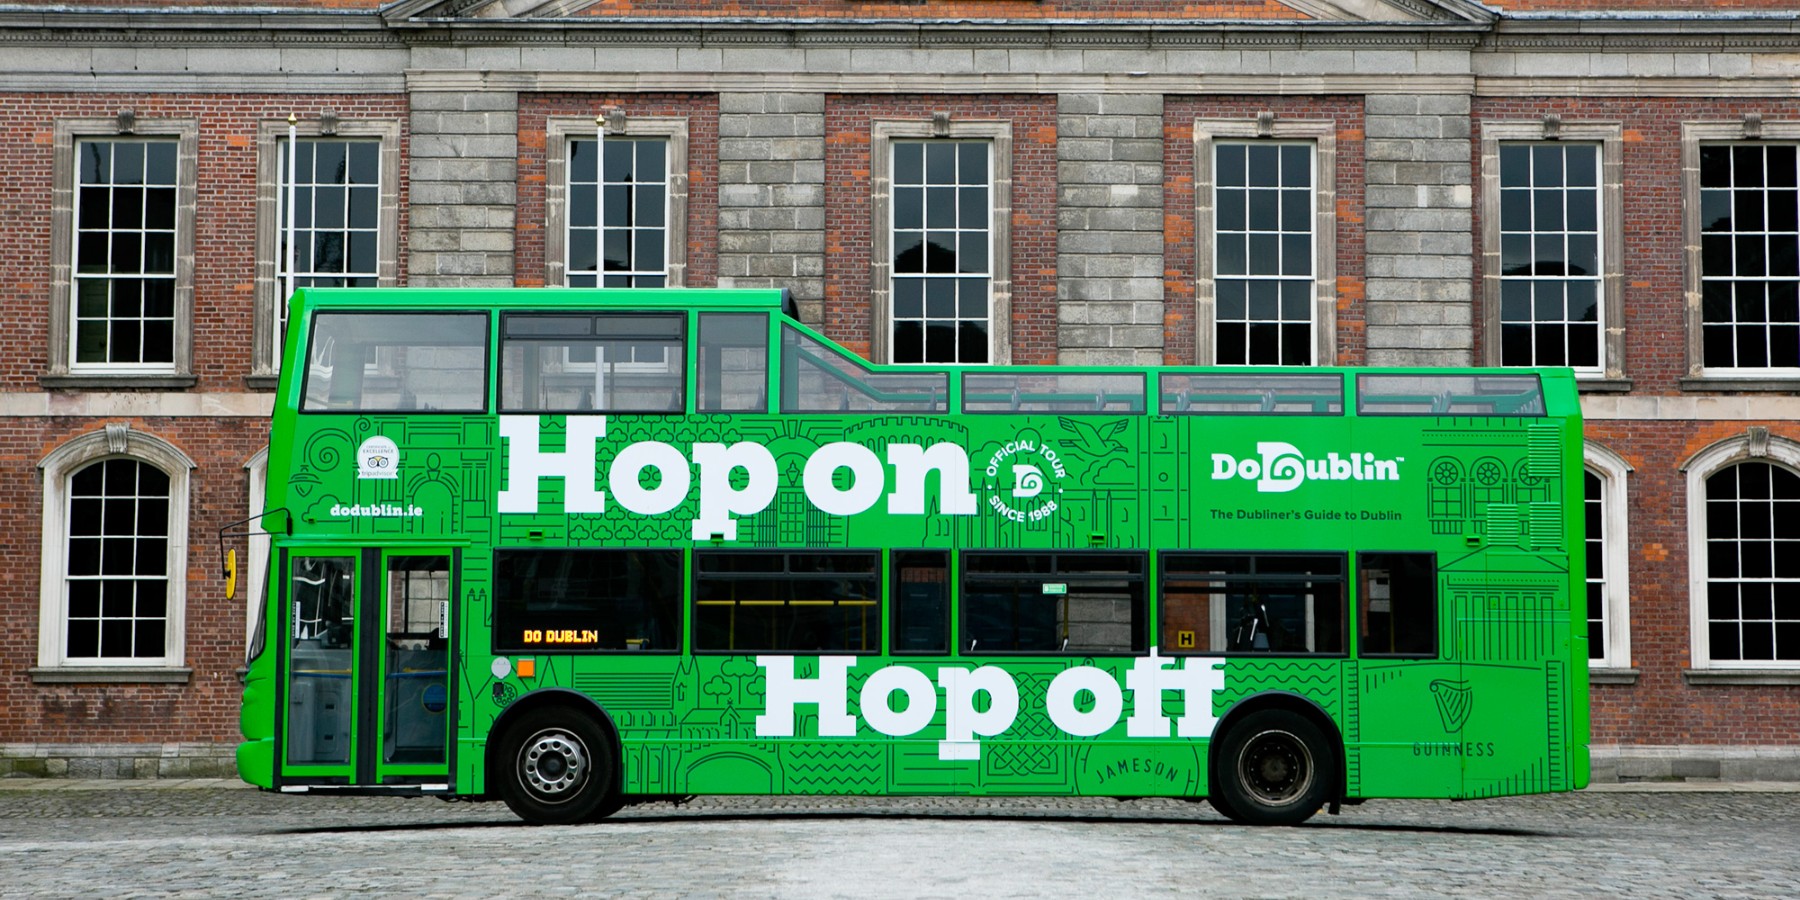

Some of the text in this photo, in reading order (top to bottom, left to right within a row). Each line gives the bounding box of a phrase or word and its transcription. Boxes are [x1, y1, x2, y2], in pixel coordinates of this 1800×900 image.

[986, 440, 1066, 478] OFFICIAL TOUR
[498, 416, 977, 540] Hop on
[330, 504, 422, 516] dodublin.ie
[989, 495, 1058, 522] SINCE 1988
[1210, 509, 1402, 520] The Dubliner's Guide to Dublin
[524, 630, 598, 642] DO DUBLIN
[1181, 633, 1192, 645] H
[756, 647, 1226, 760] Hop off
[1413, 742, 1494, 756] GUINNESS
[1096, 758, 1178, 784] JAMESON
